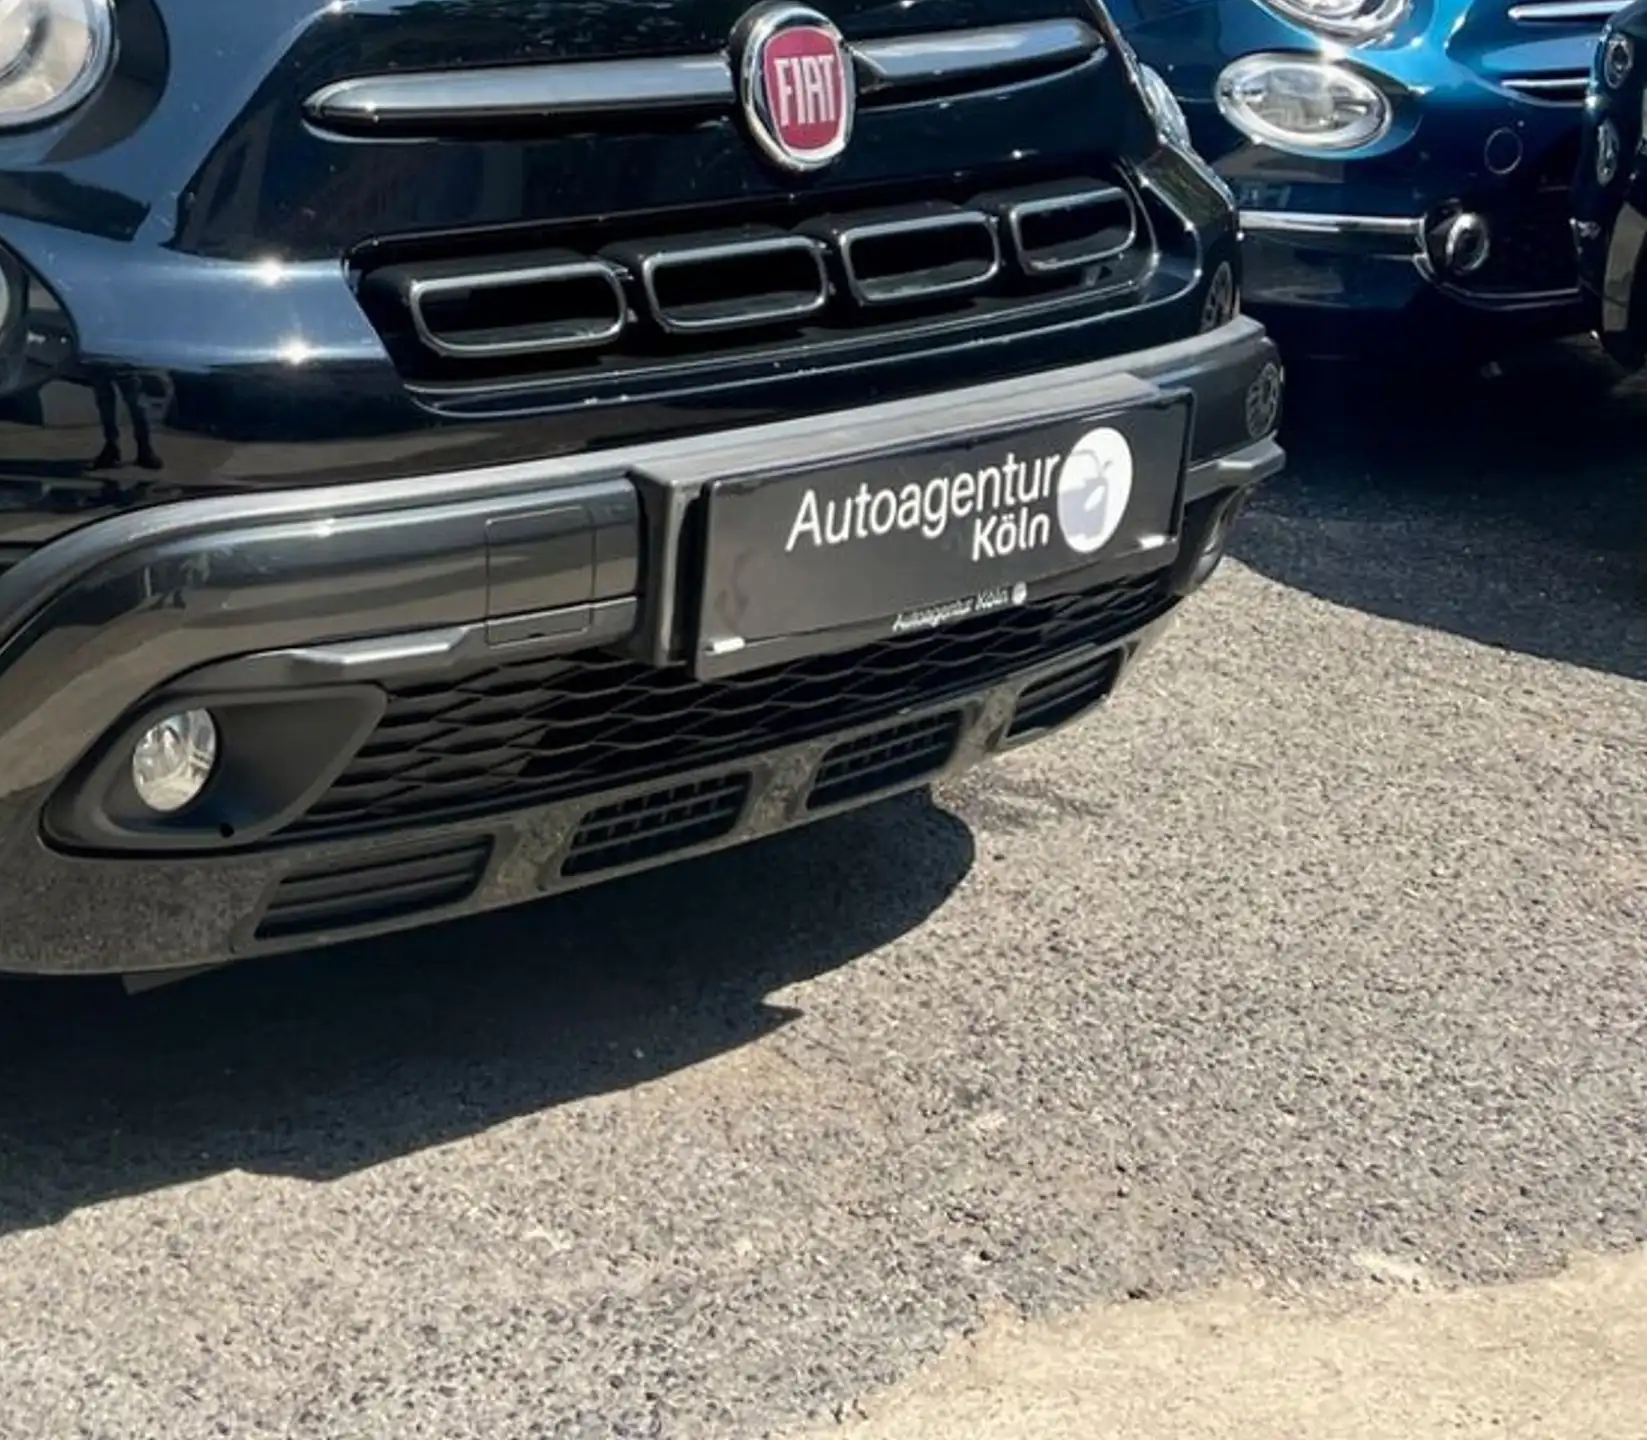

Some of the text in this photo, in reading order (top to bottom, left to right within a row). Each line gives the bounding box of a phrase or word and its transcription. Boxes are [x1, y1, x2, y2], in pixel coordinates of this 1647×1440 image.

[773, 54, 835, 127] FIAT
[785, 450, 1062, 552] Autoagentur
[972, 508, 1051, 561] Köln
